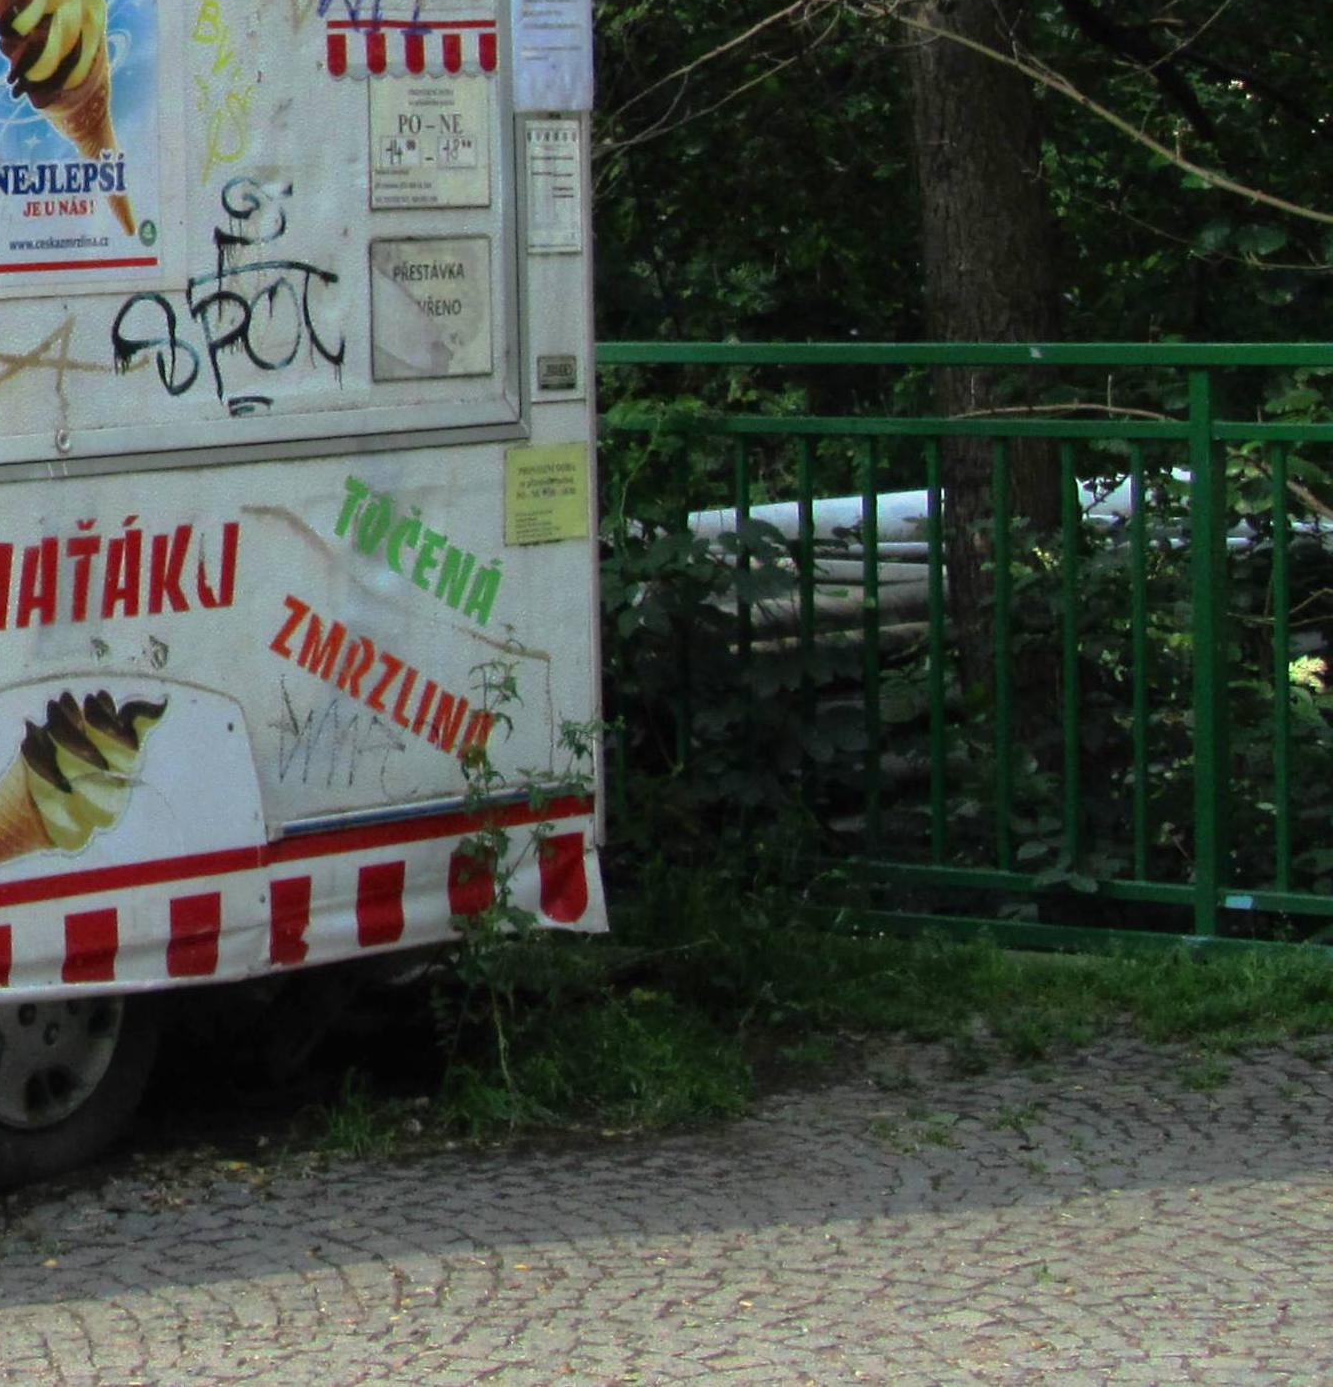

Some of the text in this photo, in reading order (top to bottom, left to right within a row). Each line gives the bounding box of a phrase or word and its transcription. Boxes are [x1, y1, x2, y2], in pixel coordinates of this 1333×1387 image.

[398, 114, 422, 134] PO
[440, 114, 464, 134] NE
[23, 200, 43, 218] JE
[44, 199, 55, 217] U
[392, 261, 466, 282] PŘESTÁVKA
[334, 474, 504, 627] TOČENÁ
[269, 594, 497, 761] ZMRZLINA
